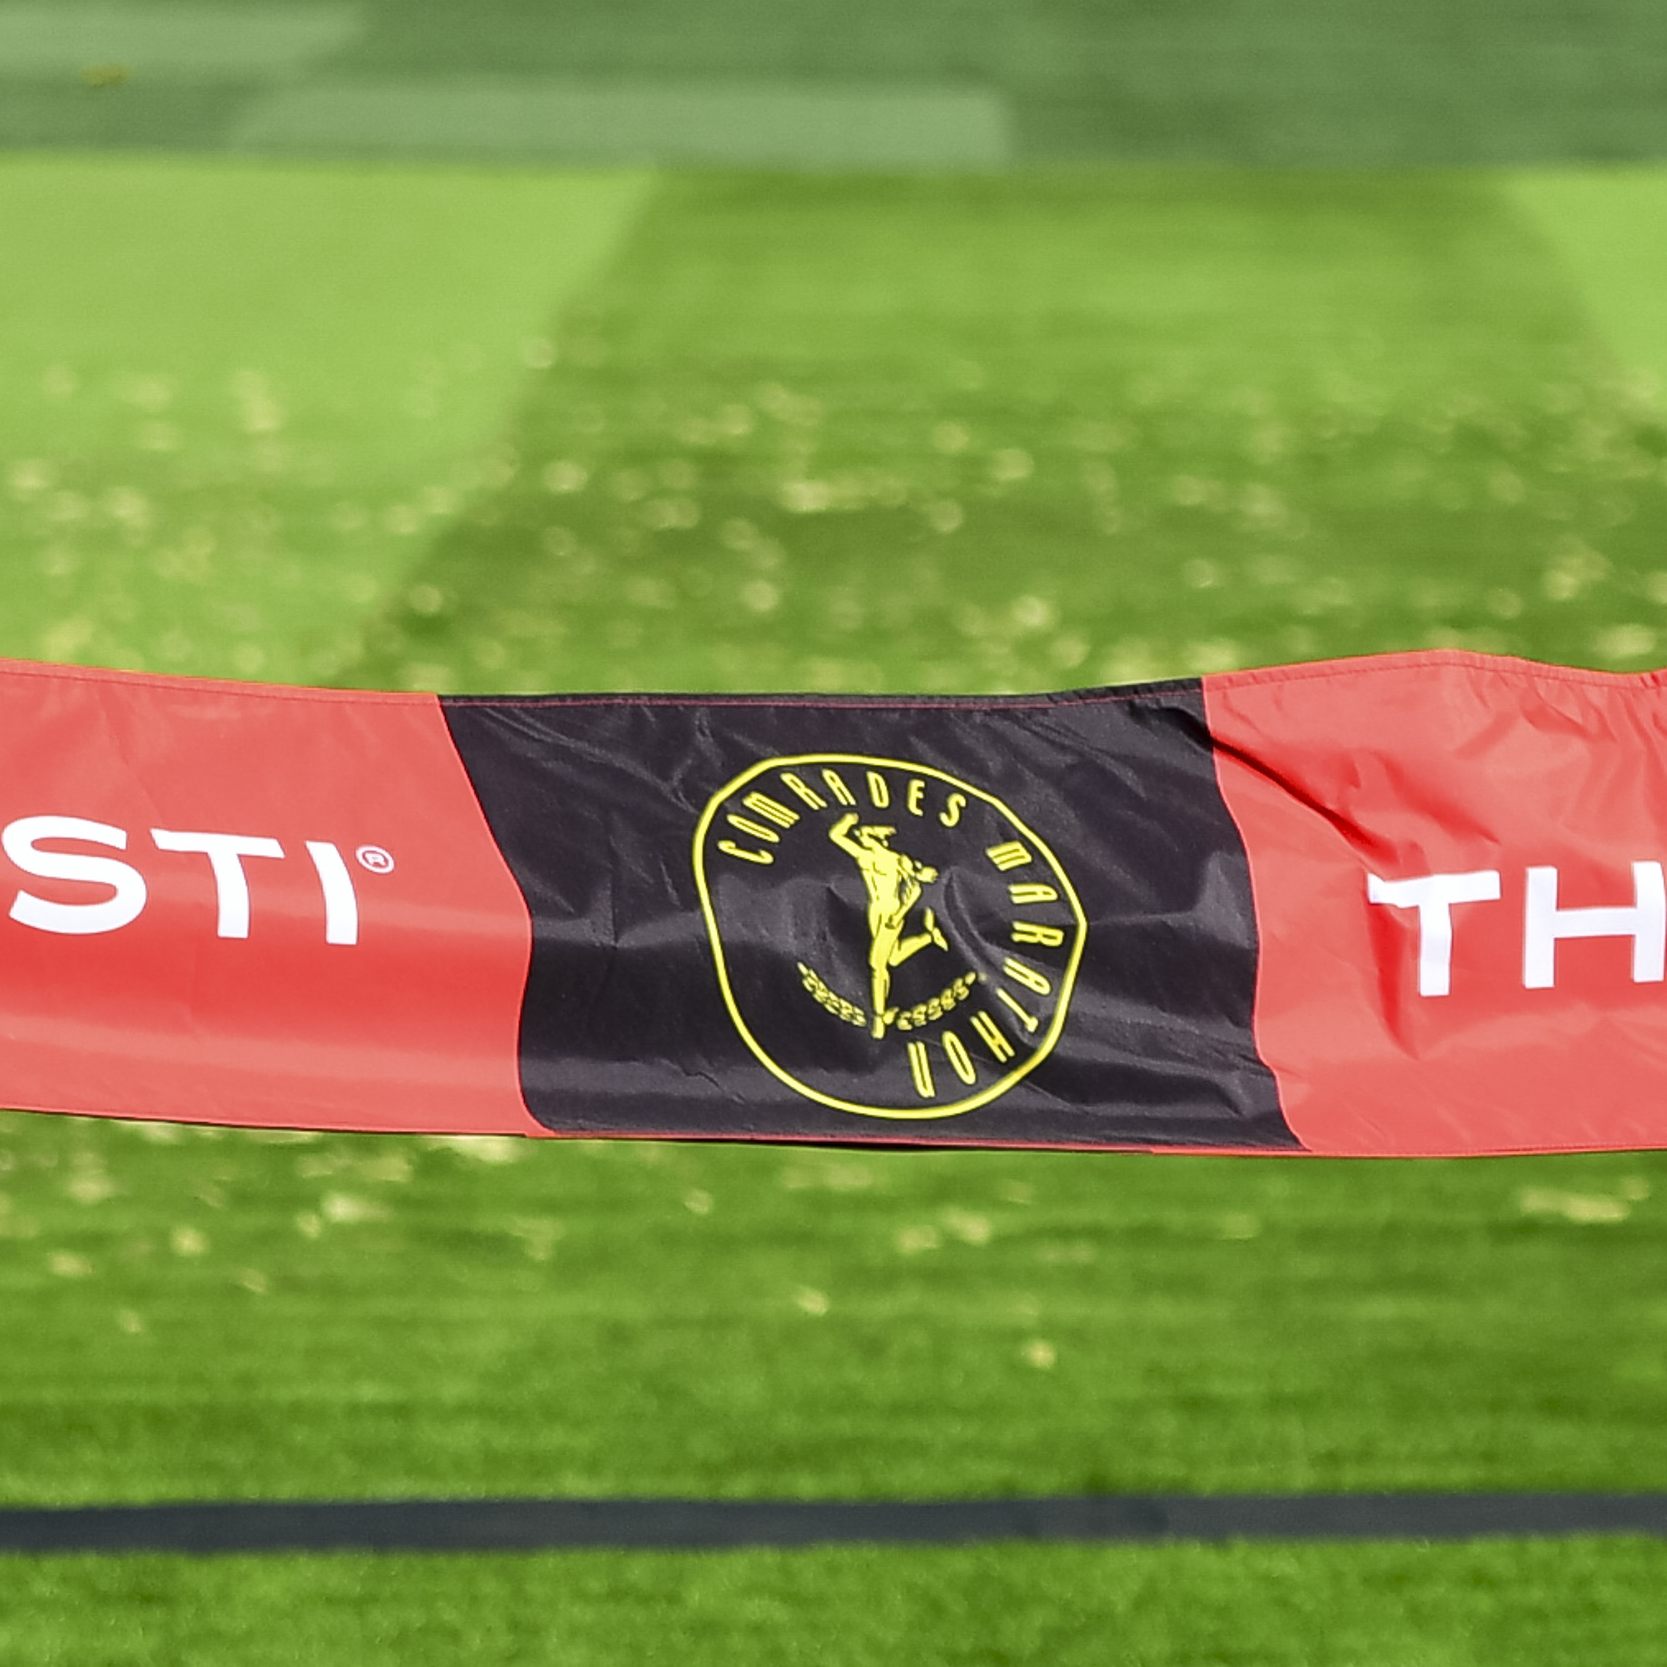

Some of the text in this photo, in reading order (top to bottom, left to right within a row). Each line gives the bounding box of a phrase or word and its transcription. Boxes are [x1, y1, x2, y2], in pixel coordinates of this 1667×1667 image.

[716, 768, 1064, 1098] COMRADES MARATHON
[1366, 860, 1667, 998] TH
